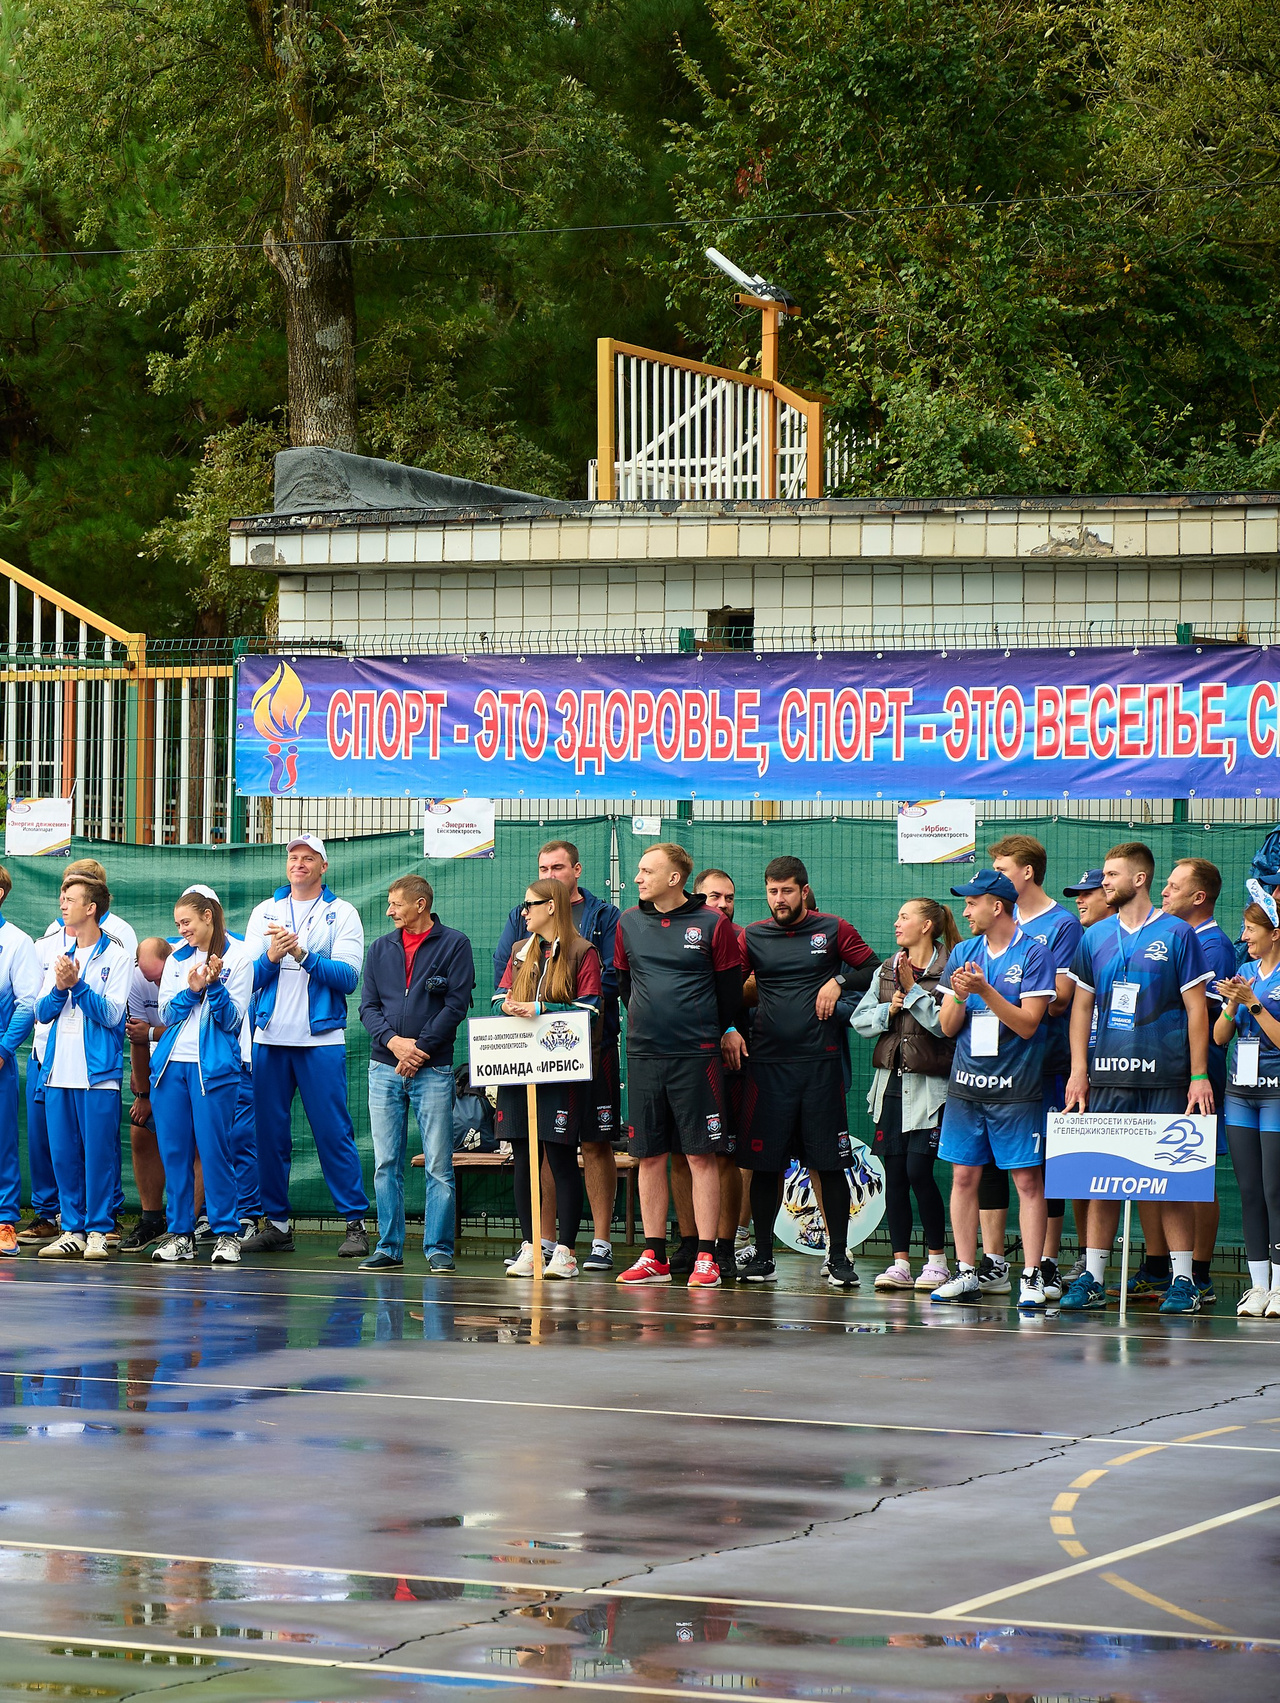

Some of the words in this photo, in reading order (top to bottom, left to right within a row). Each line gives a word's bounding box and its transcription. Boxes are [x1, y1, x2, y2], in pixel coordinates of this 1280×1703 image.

[327, 689, 448, 760] СПОРТ
[474, 688, 549, 762] ЭТО
[554, 688, 770, 778] ЗДОРОВЬЕ,
[778, 686, 913, 762] СПОРТ
[942, 685, 1024, 762] ЭТО
[1033, 683, 1238, 775] ВЕСЕЛЬЕ,
[1246, 680, 1280, 759] С
[441, 821, 478, 829] «Энергия»
[921, 825, 953, 833] «Ирбис»
[476, 1062, 534, 1077] КОМАНДА
[536, 1059, 584, 1073] «ИРБИС»
[1095, 1058, 1156, 1073] ШТОРМ
[956, 1070, 1013, 1089] ШТОРМ
[1053, 1128, 1158, 1136] «ГЕЛЕНДЖИКЭЛЕКТРОСЕТЬ»
[1032, 1132, 1040, 1154] 7
[1089, 1176, 1168, 1194] ШТОРМ
